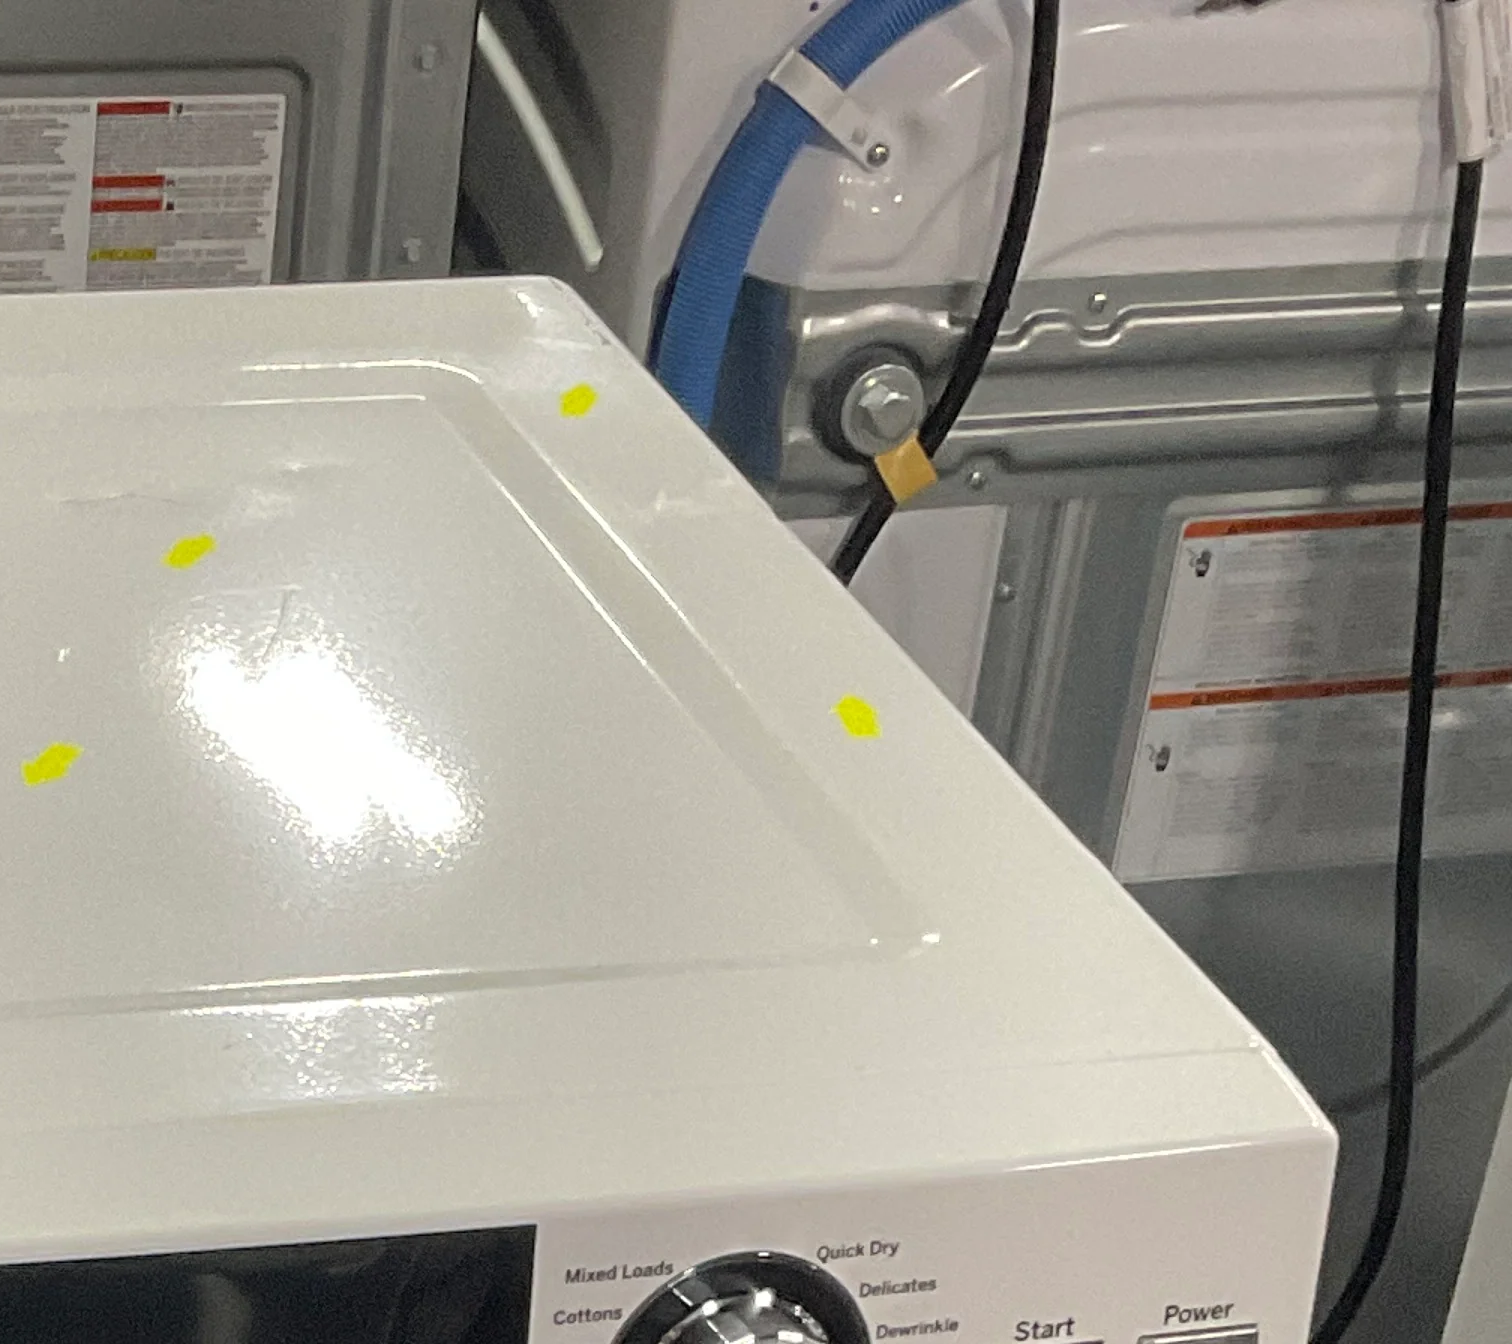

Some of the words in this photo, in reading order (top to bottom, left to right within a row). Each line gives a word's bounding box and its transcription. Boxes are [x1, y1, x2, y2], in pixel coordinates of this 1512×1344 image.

[817, 1241, 865, 1262] Quick
[869, 1239, 900, 1258] Dry
[565, 1265, 618, 1285] Mixed
[622, 1260, 674, 1281] Loads
[859, 1276, 937, 1299] Delicates
[553, 1305, 623, 1326] Cottons
[1163, 1302, 1235, 1326] Power
[876, 1318, 960, 1340] Dewrinkle
[1014, 1317, 1076, 1341] Start
